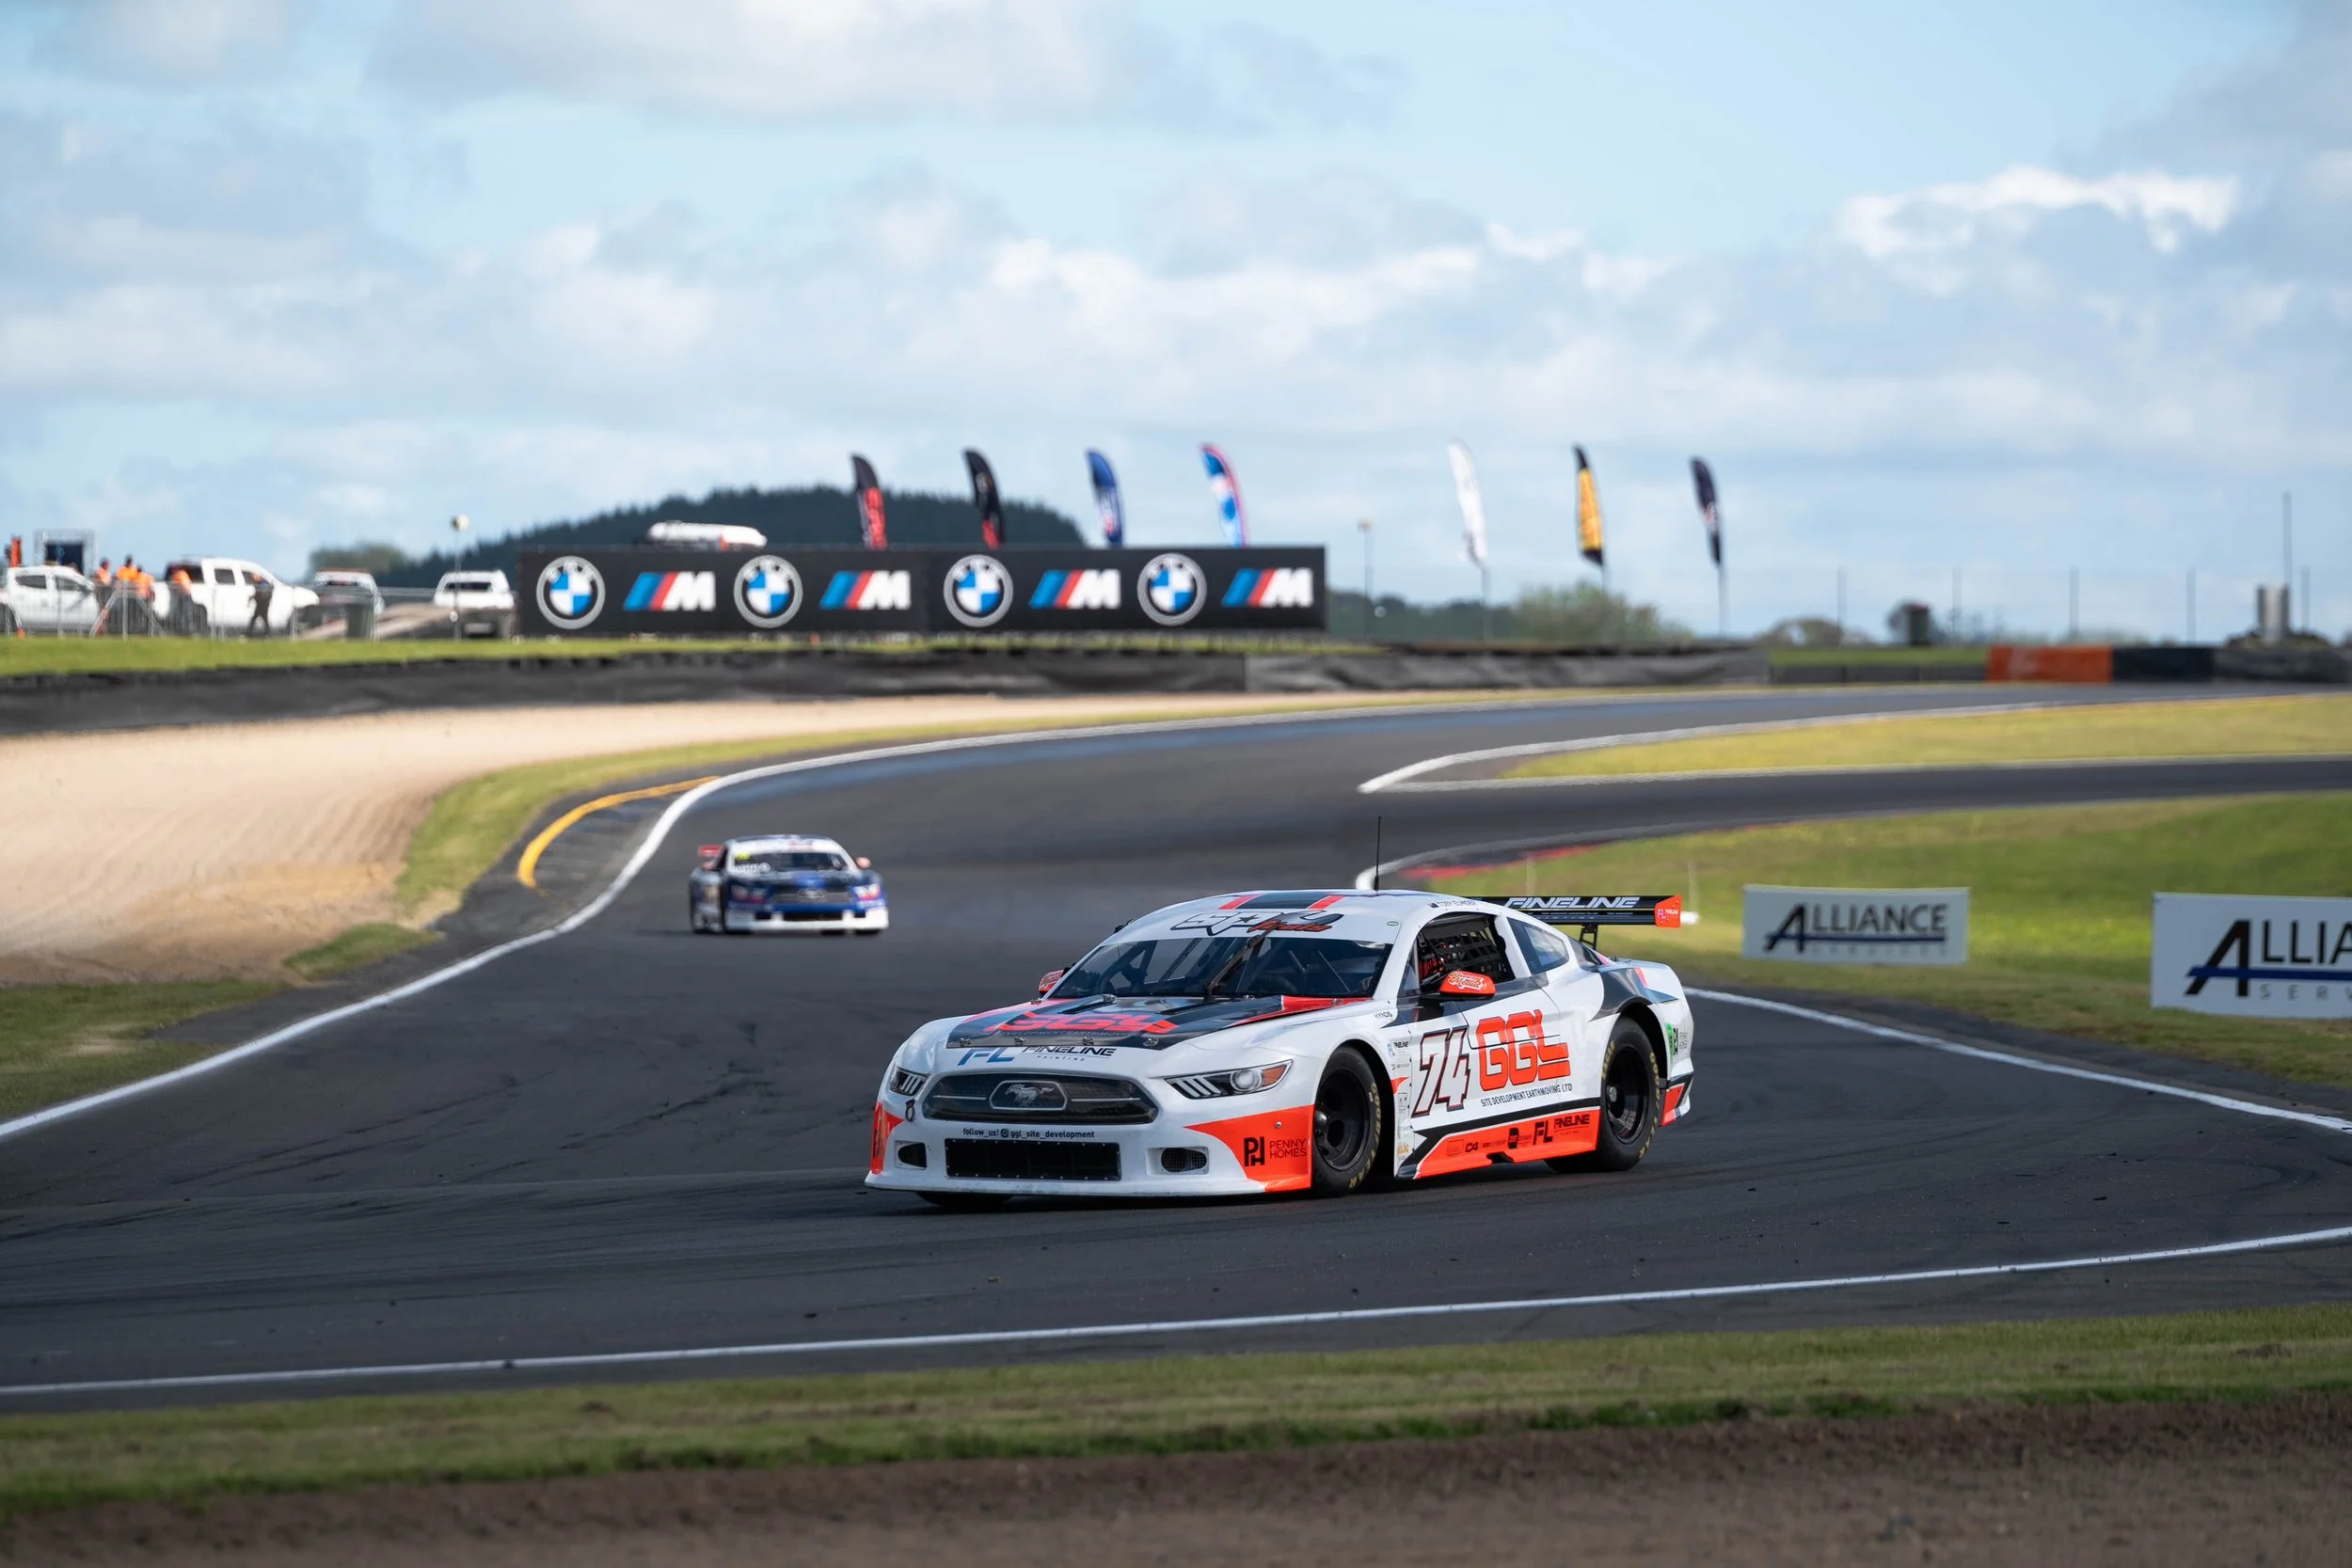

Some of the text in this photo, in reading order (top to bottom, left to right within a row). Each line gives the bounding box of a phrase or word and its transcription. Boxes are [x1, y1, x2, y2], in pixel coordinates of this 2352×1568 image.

[661, 571, 716, 611] M
[858, 570, 911, 610] M
[1067, 568, 1121, 609] M
[1260, 568, 1314, 608] M
[1504, 896, 1640, 909] FINELINE
[1762, 902, 1948, 953] ALLIANCE
[1022, 1046, 1117, 1056] FINELINE
[1476, 1009, 1571, 1091] GGL
[1411, 1024, 1470, 1118] 74
[1481, 1083, 1573, 1107] SITE DEVELOPMENT EARTHMOVING LTD
[1269, 1138, 1307, 1149] PENNY
[1269, 1148, 1307, 1159] HOMES
